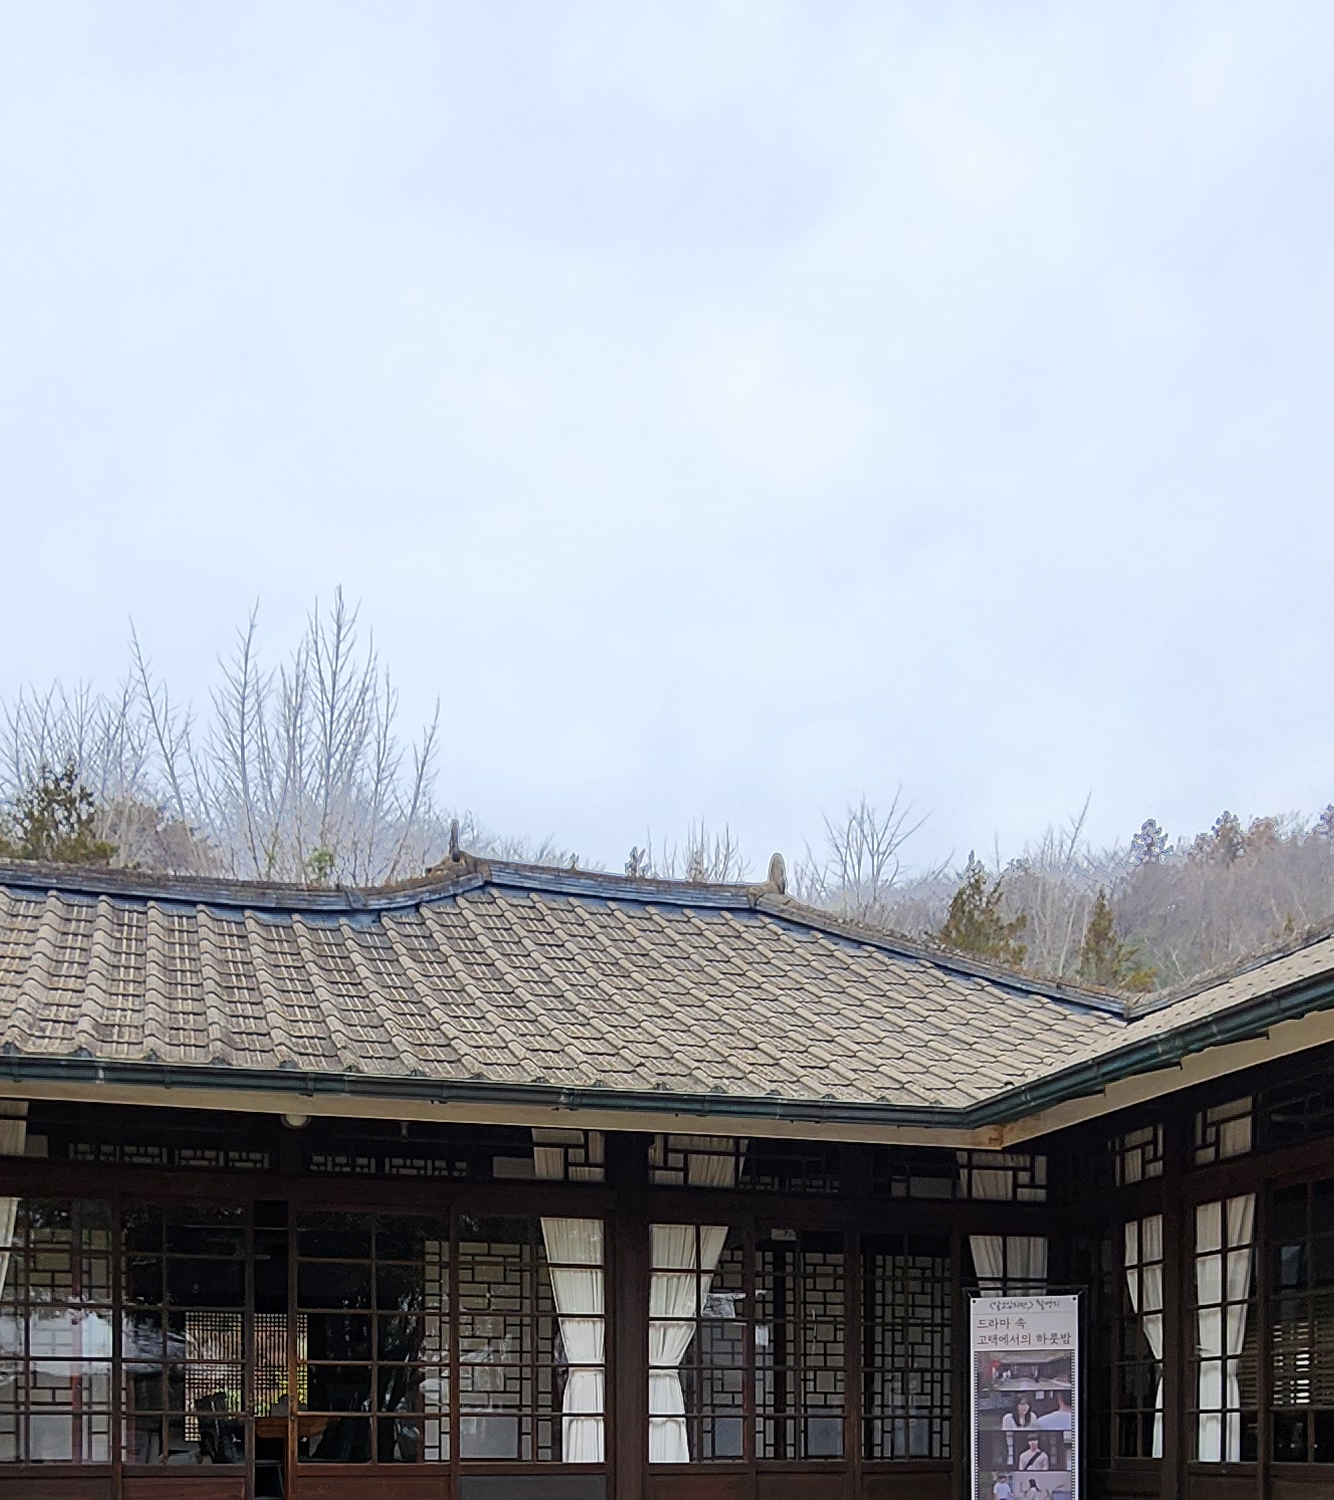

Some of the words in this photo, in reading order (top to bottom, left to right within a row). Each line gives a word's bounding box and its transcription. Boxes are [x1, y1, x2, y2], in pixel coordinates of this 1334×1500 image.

[977, 1317, 1011, 1329] 드라마
[1015, 1317, 1027, 1329] 속
[977, 1333, 1031, 1346] 고택에서의
[1036, 1332, 1072, 1345] 하룻밤
